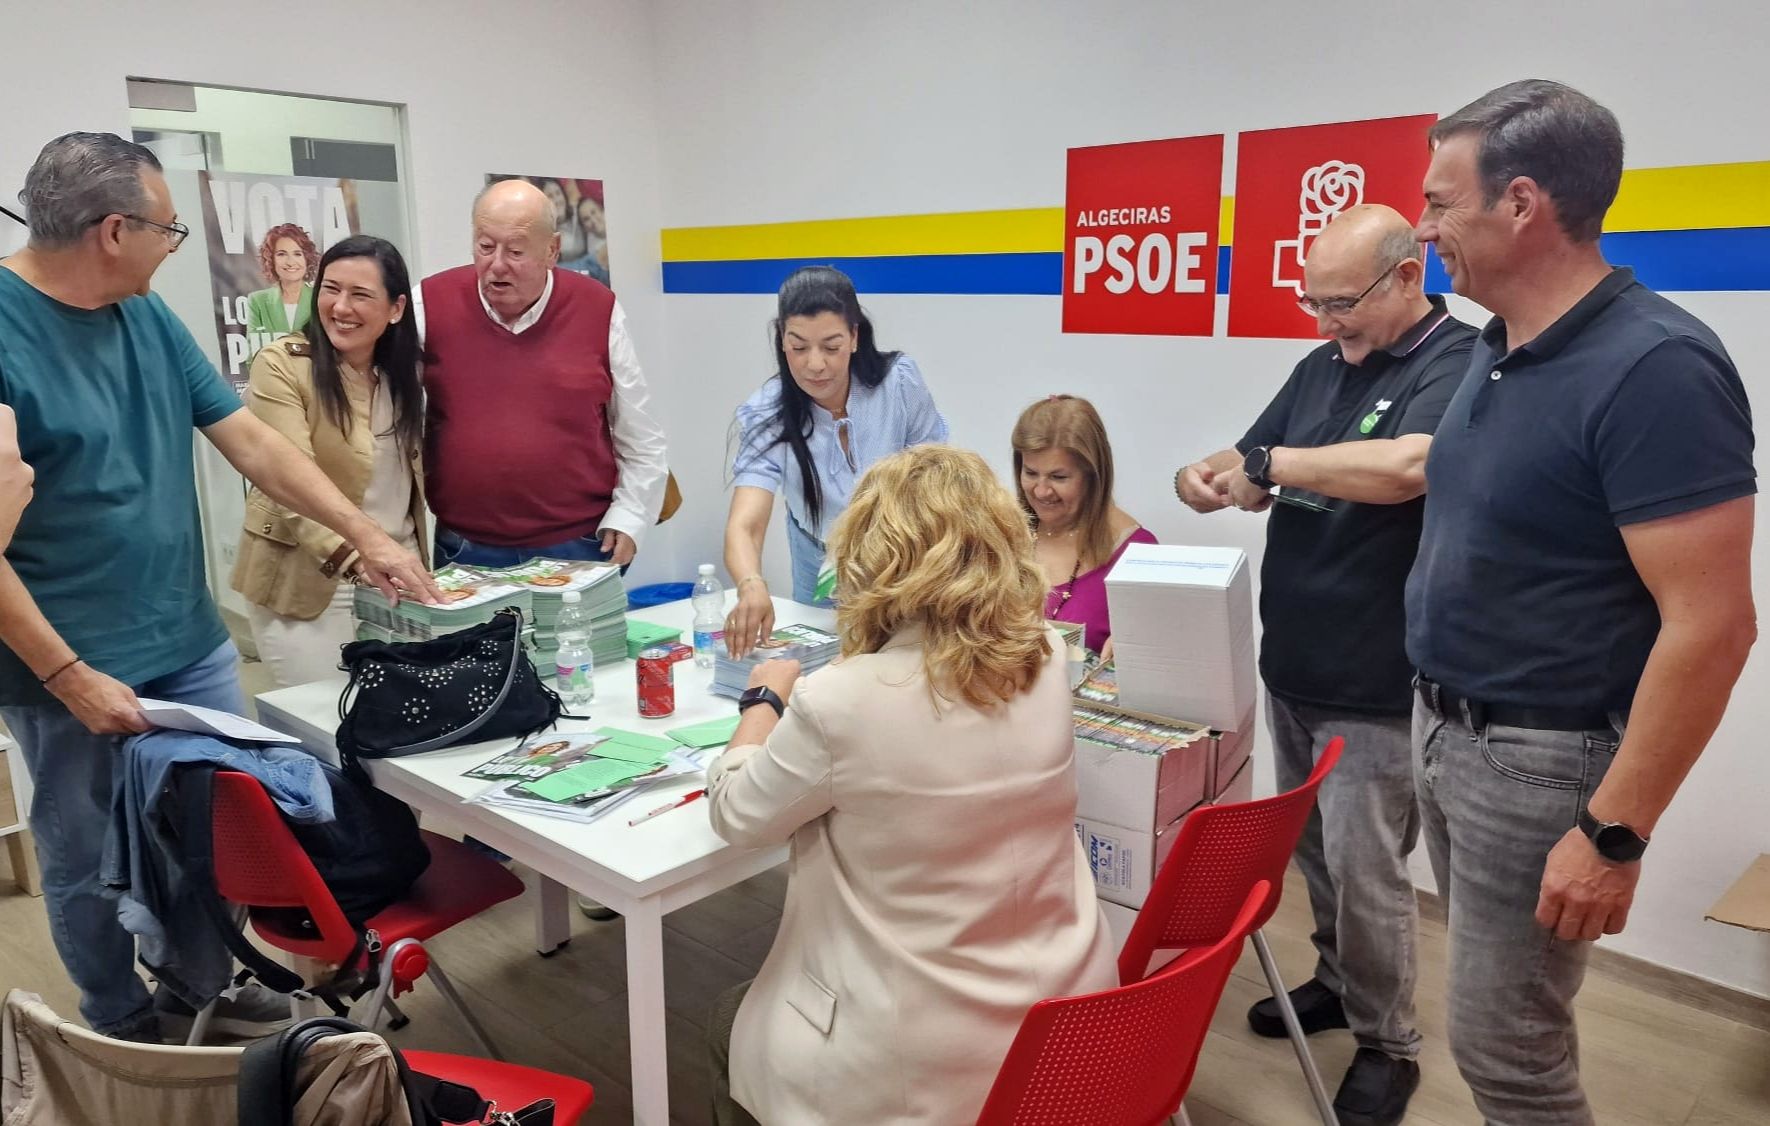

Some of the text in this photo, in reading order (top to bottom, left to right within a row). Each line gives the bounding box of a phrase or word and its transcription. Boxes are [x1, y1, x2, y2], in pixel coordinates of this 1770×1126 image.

[209, 180, 351, 254] VOTA
[1076, 206, 1171, 227] ALGECIRAS
[1073, 232, 1207, 294] PSOE
[222, 296, 248, 325] LO
